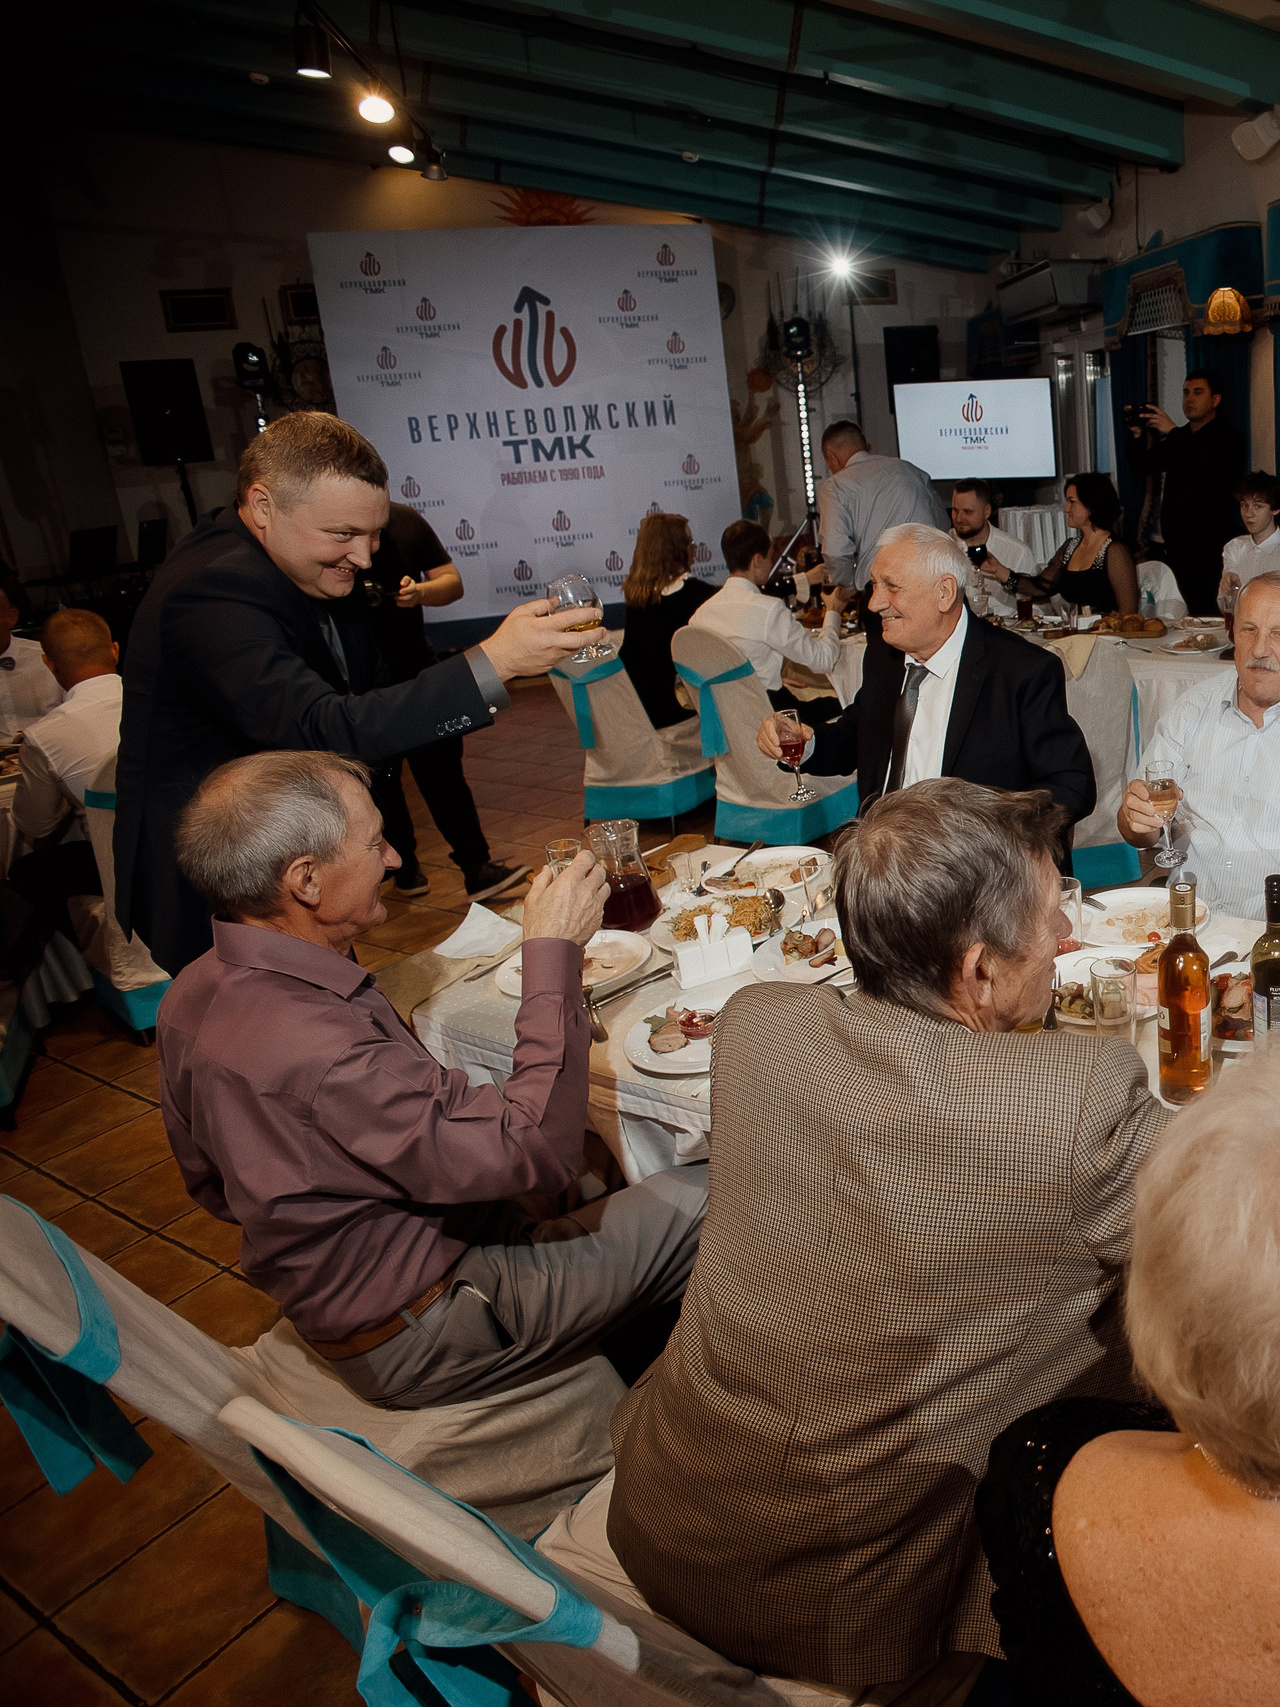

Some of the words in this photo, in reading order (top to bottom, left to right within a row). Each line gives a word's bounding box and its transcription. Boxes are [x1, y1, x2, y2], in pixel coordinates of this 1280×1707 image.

[407, 394, 677, 444] ВЕРХНЕВОЛЖСКИЙ
[502, 433, 595, 465] ТМК
[500, 470, 548, 487] РАБОТАЕМ
[549, 469, 557, 483] С
[558, 467, 580, 482] 1990
[582, 464, 606, 480] ГОДА
